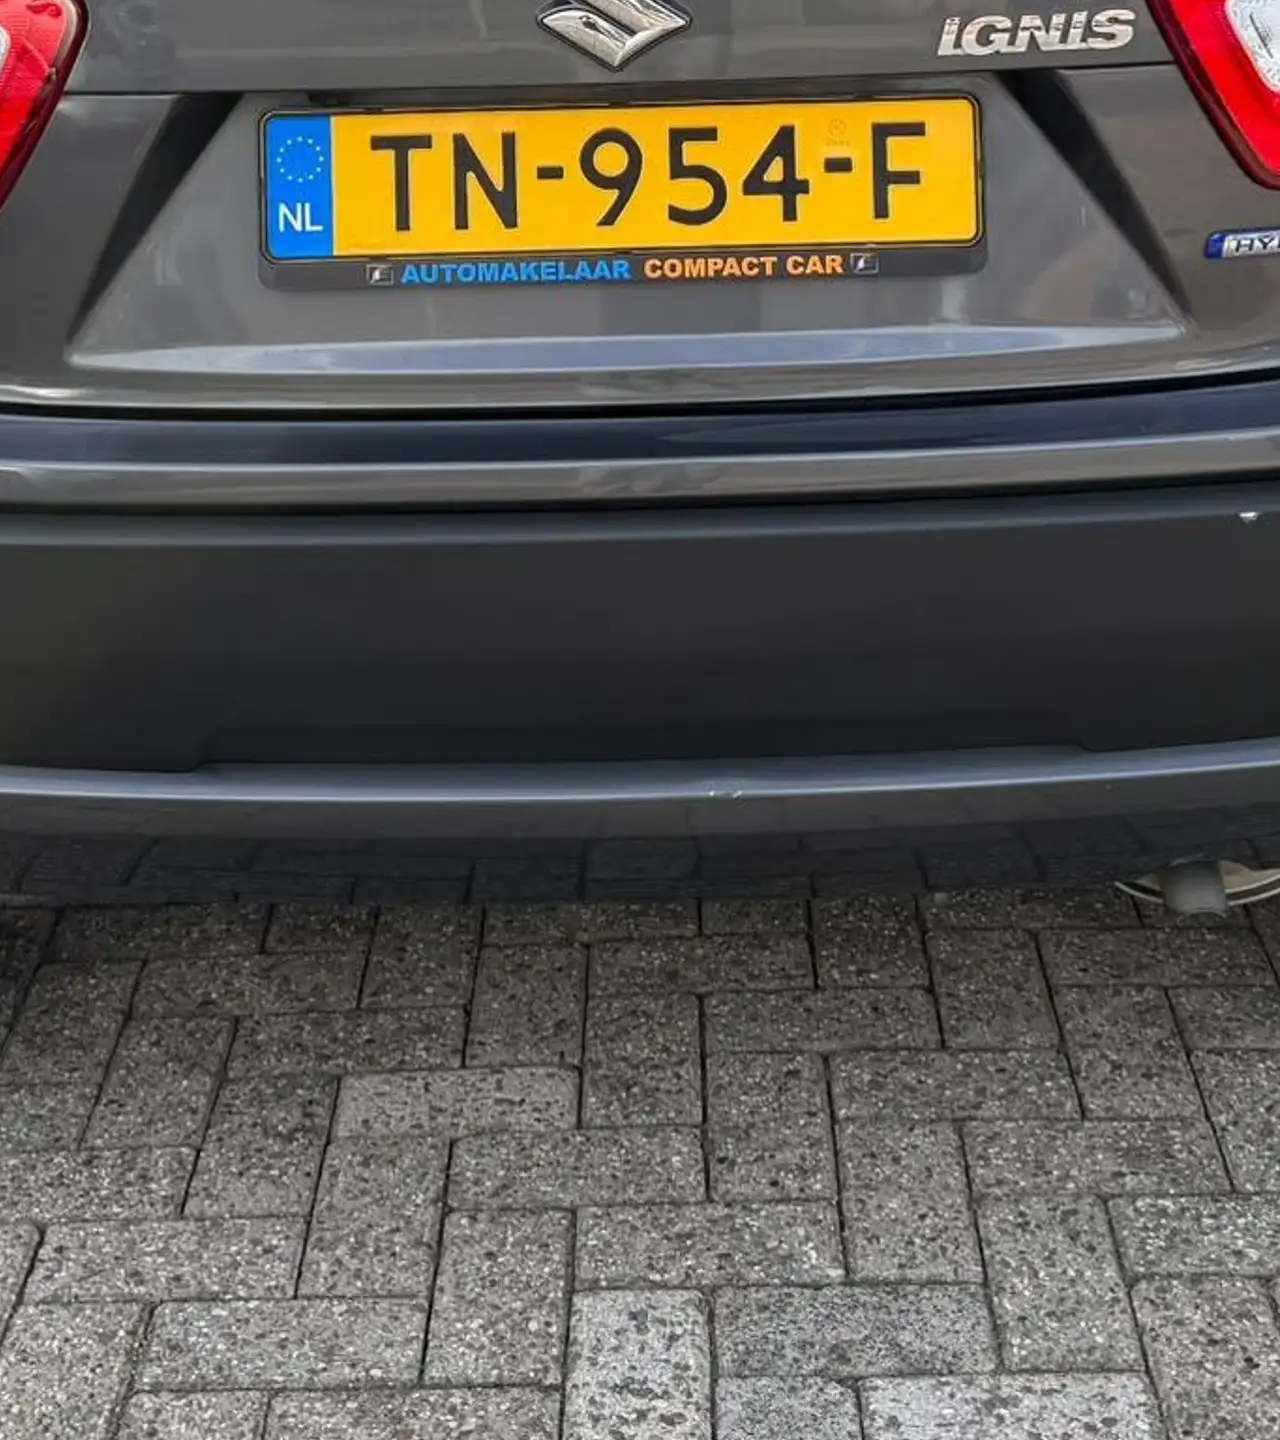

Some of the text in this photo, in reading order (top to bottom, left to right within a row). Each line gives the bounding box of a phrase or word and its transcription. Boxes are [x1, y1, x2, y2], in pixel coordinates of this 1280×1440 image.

[938, 9, 1137, 57] IGNIS
[370, 121, 926, 233] TN-954-F
[278, 203, 322, 233] NL
[400, 254, 844, 285] AUTOMAKELAAR COMPACT CAR
